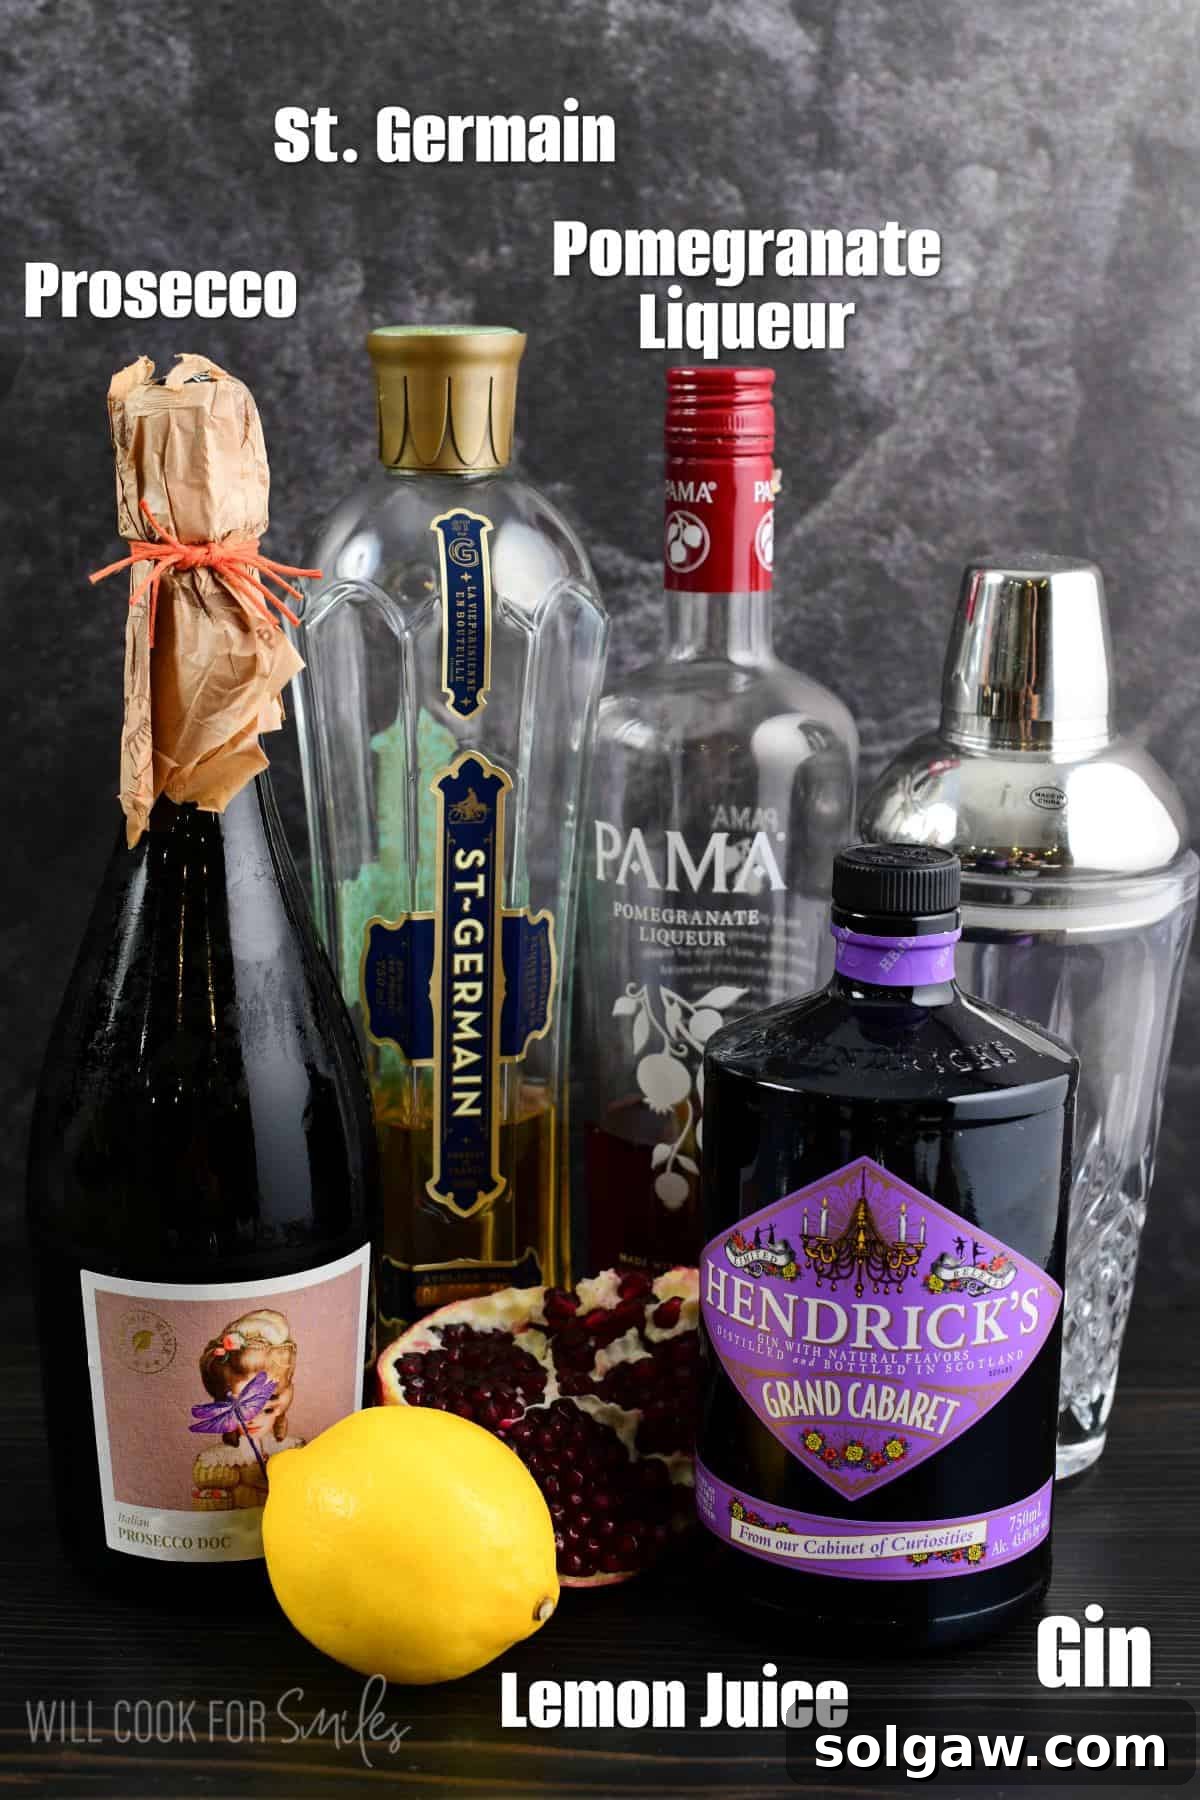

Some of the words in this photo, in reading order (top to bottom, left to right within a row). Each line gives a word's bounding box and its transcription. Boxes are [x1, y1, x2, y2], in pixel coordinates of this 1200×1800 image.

[594, 819, 788, 894] PAMA
[613, 901, 760, 926] POMEGRANATE
[639, 926, 728, 948] LIQUEUR
[706, 1259, 1041, 1353] HENDRICK'S
[715, 1324, 785, 1361] DISTILLED
[824, 1360, 906, 1376] BOTTLED
[916, 1363, 936, 1376] IN
[944, 1349, 1025, 1374] SCOTLAND
[757, 1333, 780, 1348] GIN
[784, 1340, 822, 1358] WITH
[829, 1349, 898, 1365] NATURAL
[905, 1350, 970, 1366] FLAVORS
[762, 1379, 841, 1420] GRAND
[847, 1380, 961, 1436] CABARET
[117, 1512, 150, 1528] Italian
[118, 1527, 193, 1550] PROSECCO
[197, 1536, 232, 1550] DOC
[737, 1524, 773, 1550] From
[775, 1535, 800, 1554] our
[803, 1534, 865, 1555] Cabinet
[870, 1534, 889, 1558] of
[891, 1528, 975, 1552] Curiosities
